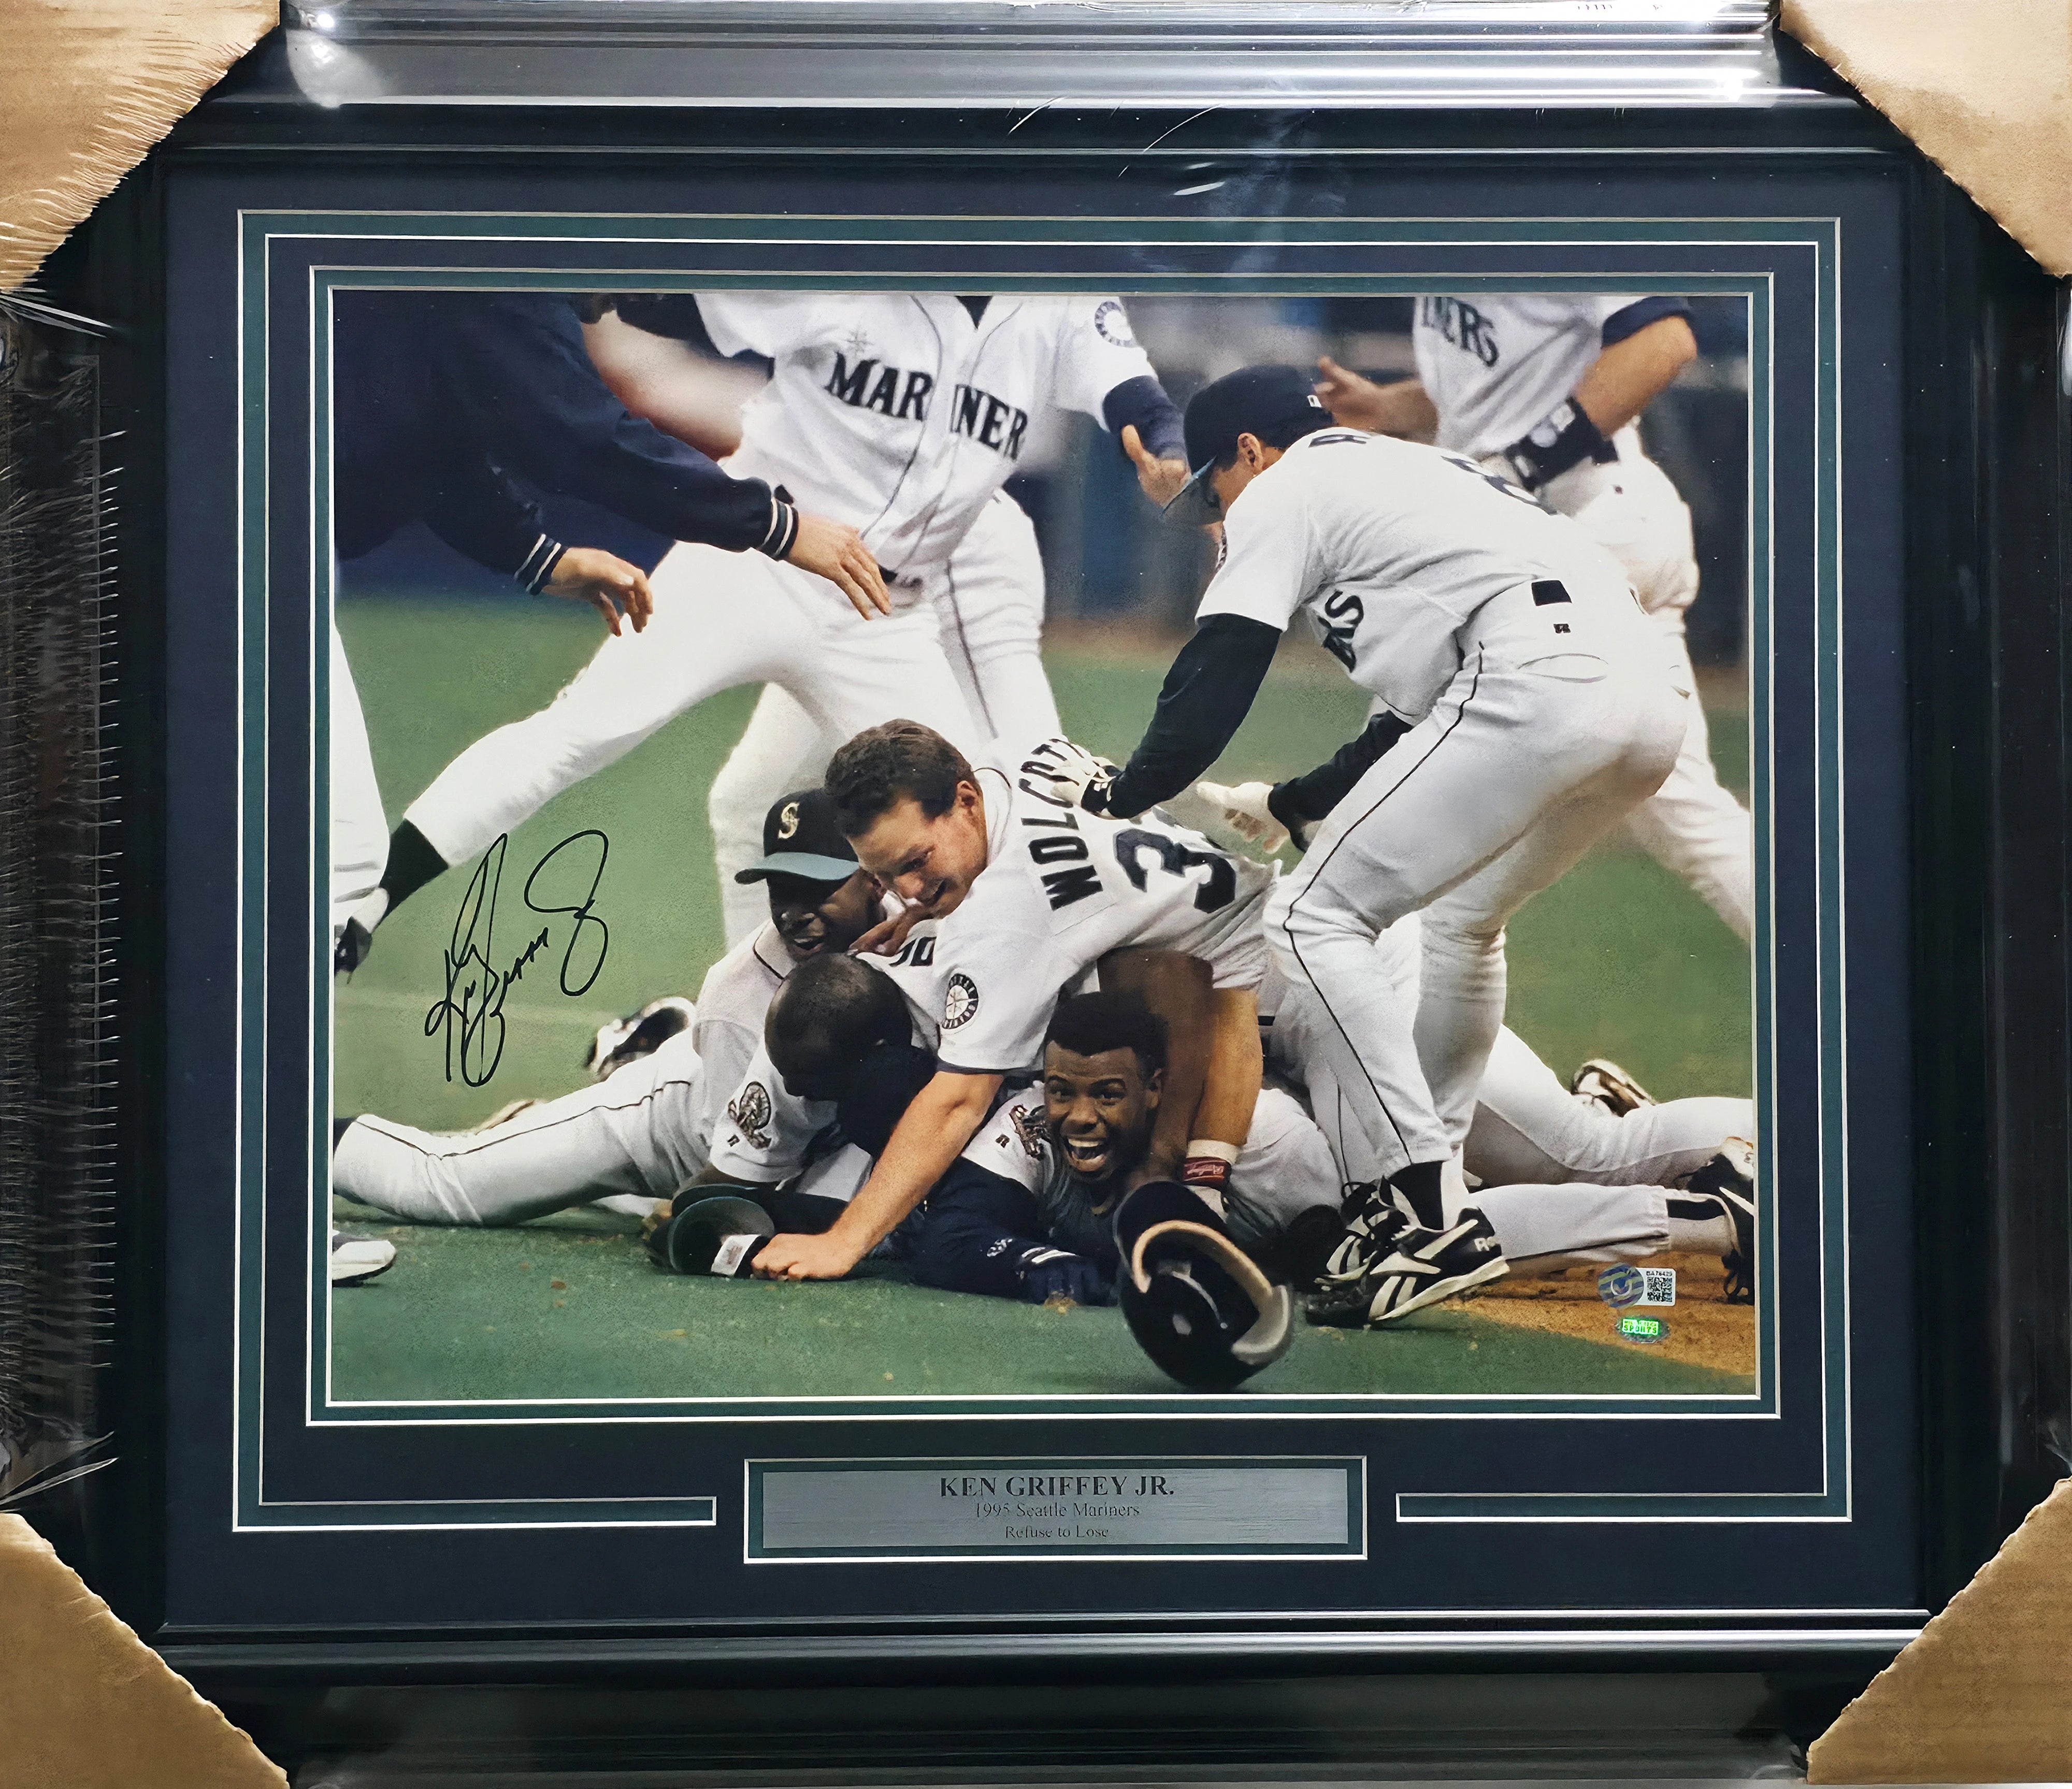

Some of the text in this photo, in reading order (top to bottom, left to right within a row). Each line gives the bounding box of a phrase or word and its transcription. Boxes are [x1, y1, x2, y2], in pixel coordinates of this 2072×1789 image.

[940, 1475, 1174, 1497] KEN GRIFFEY JR.
[976, 1502, 1140, 1518] 1995 Seattle Mariners
[1005, 1525, 1110, 1539] Refuse to Lose
